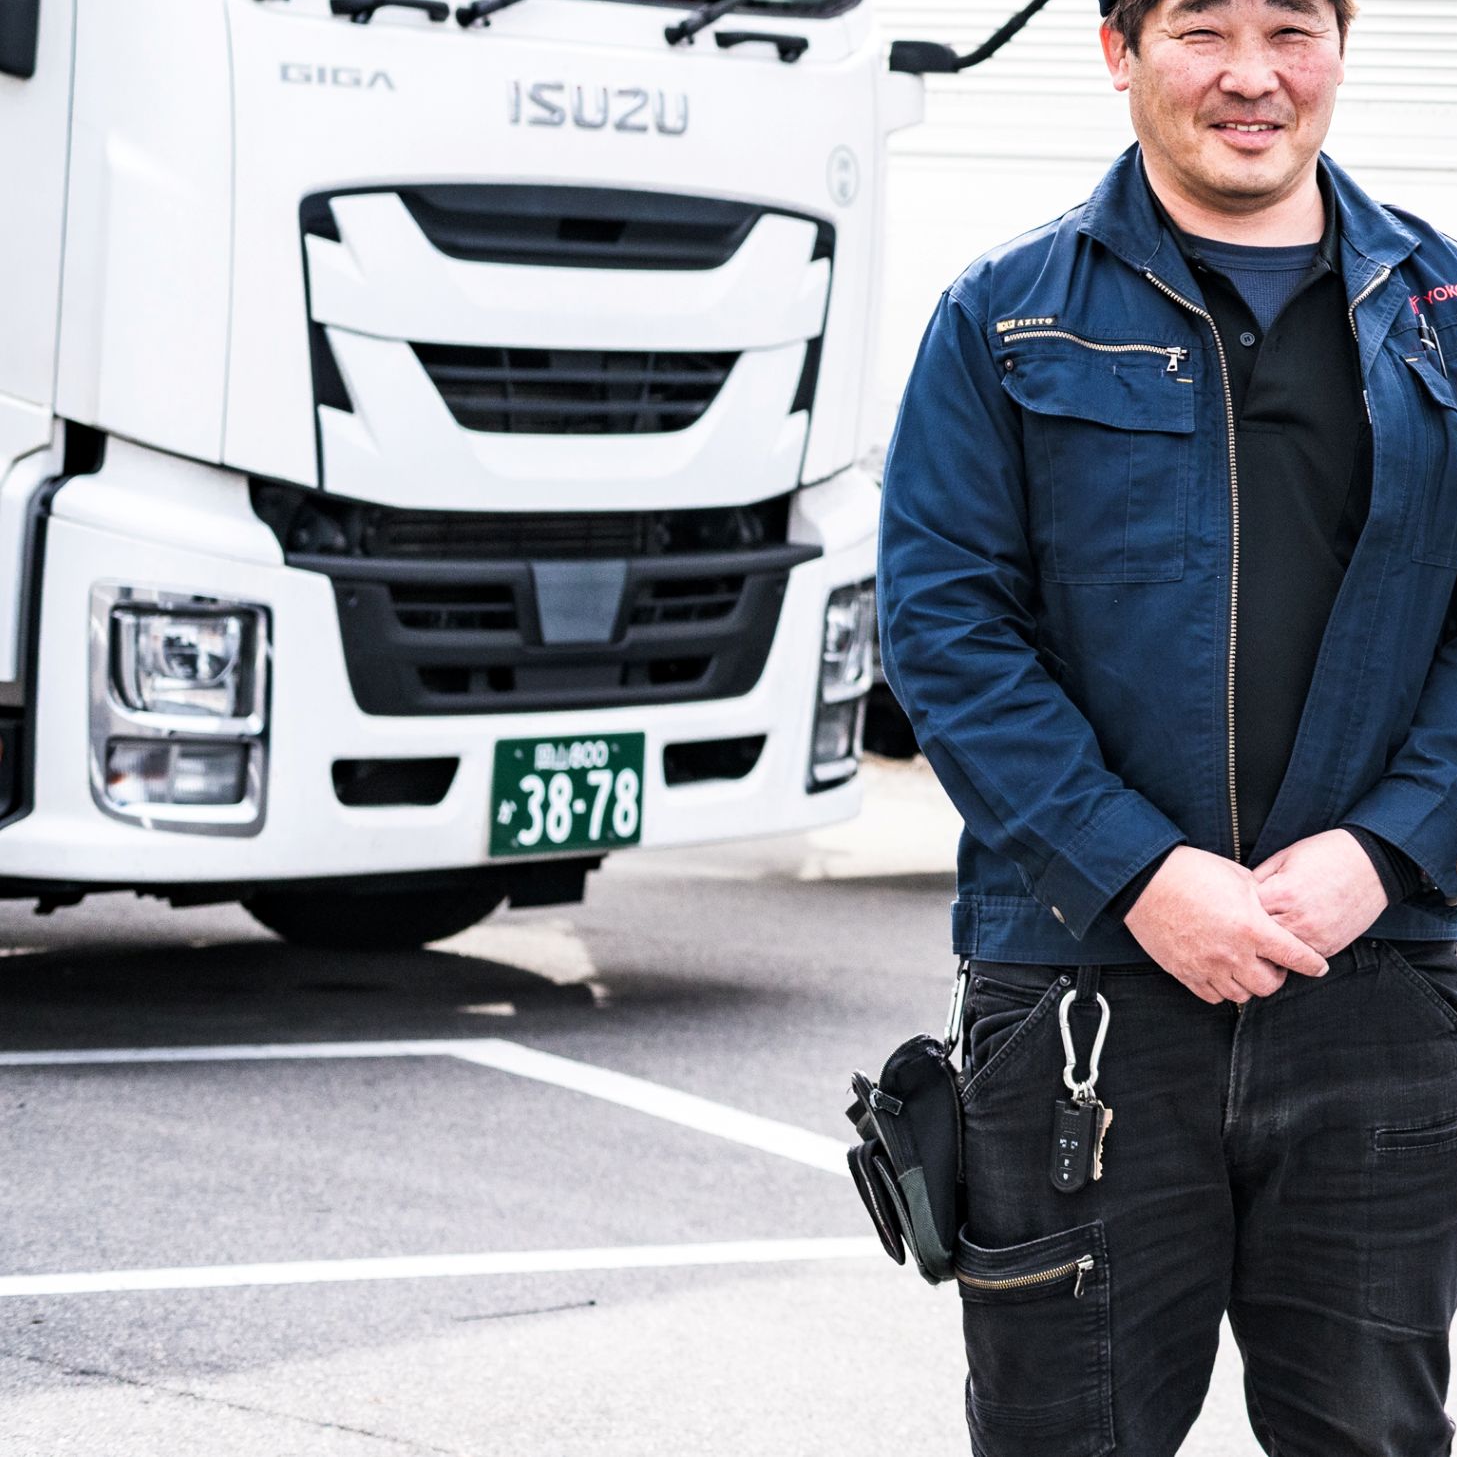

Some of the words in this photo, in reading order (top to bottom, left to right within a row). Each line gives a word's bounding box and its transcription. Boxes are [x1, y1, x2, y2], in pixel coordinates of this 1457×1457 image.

[280, 63, 396, 91] GIGA
[509, 80, 690, 136] ISUZU
[1017, 317, 1053, 327] AZITO
[517, 767, 639, 847] 38-78
